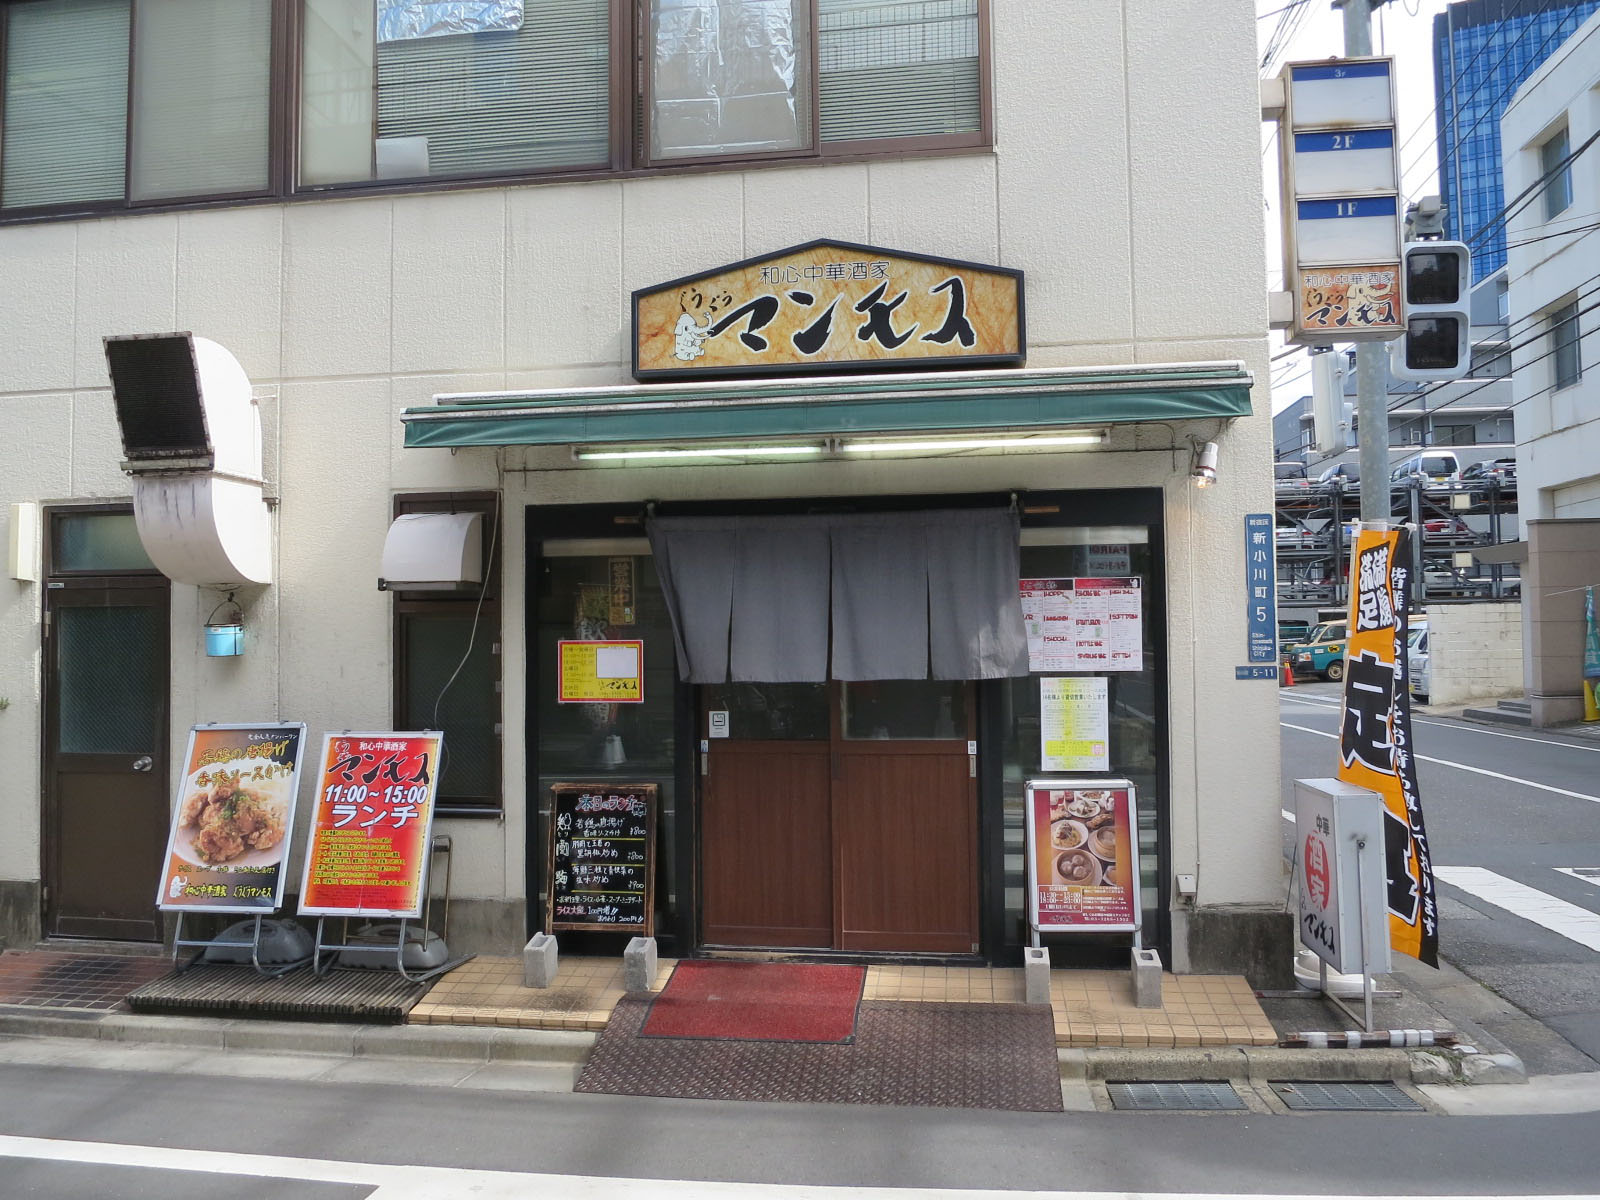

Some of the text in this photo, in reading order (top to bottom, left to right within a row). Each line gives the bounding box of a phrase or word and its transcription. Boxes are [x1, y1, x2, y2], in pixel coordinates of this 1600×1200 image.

[1335, 68, 1347, 78] 3F
[1332, 134, 1355, 149] 2F
[1336, 202, 1358, 217] 1F
[759, 260, 891, 284] 和心中華酒家
[1305, 271, 1394, 288] 和心中華酒家
[706, 276, 977, 355] マンモス
[1305, 302, 1396, 326] マンモス
[1252, 668, 1274, 677] 5-11
[358, 741, 407, 752] 和心中華酒家
[328, 752, 430, 785] マンモス
[575, 793, 637, 812] 本日のランチ
[331, 804, 420, 830] ランチ
[1316, 813, 1330, 838] 中華
